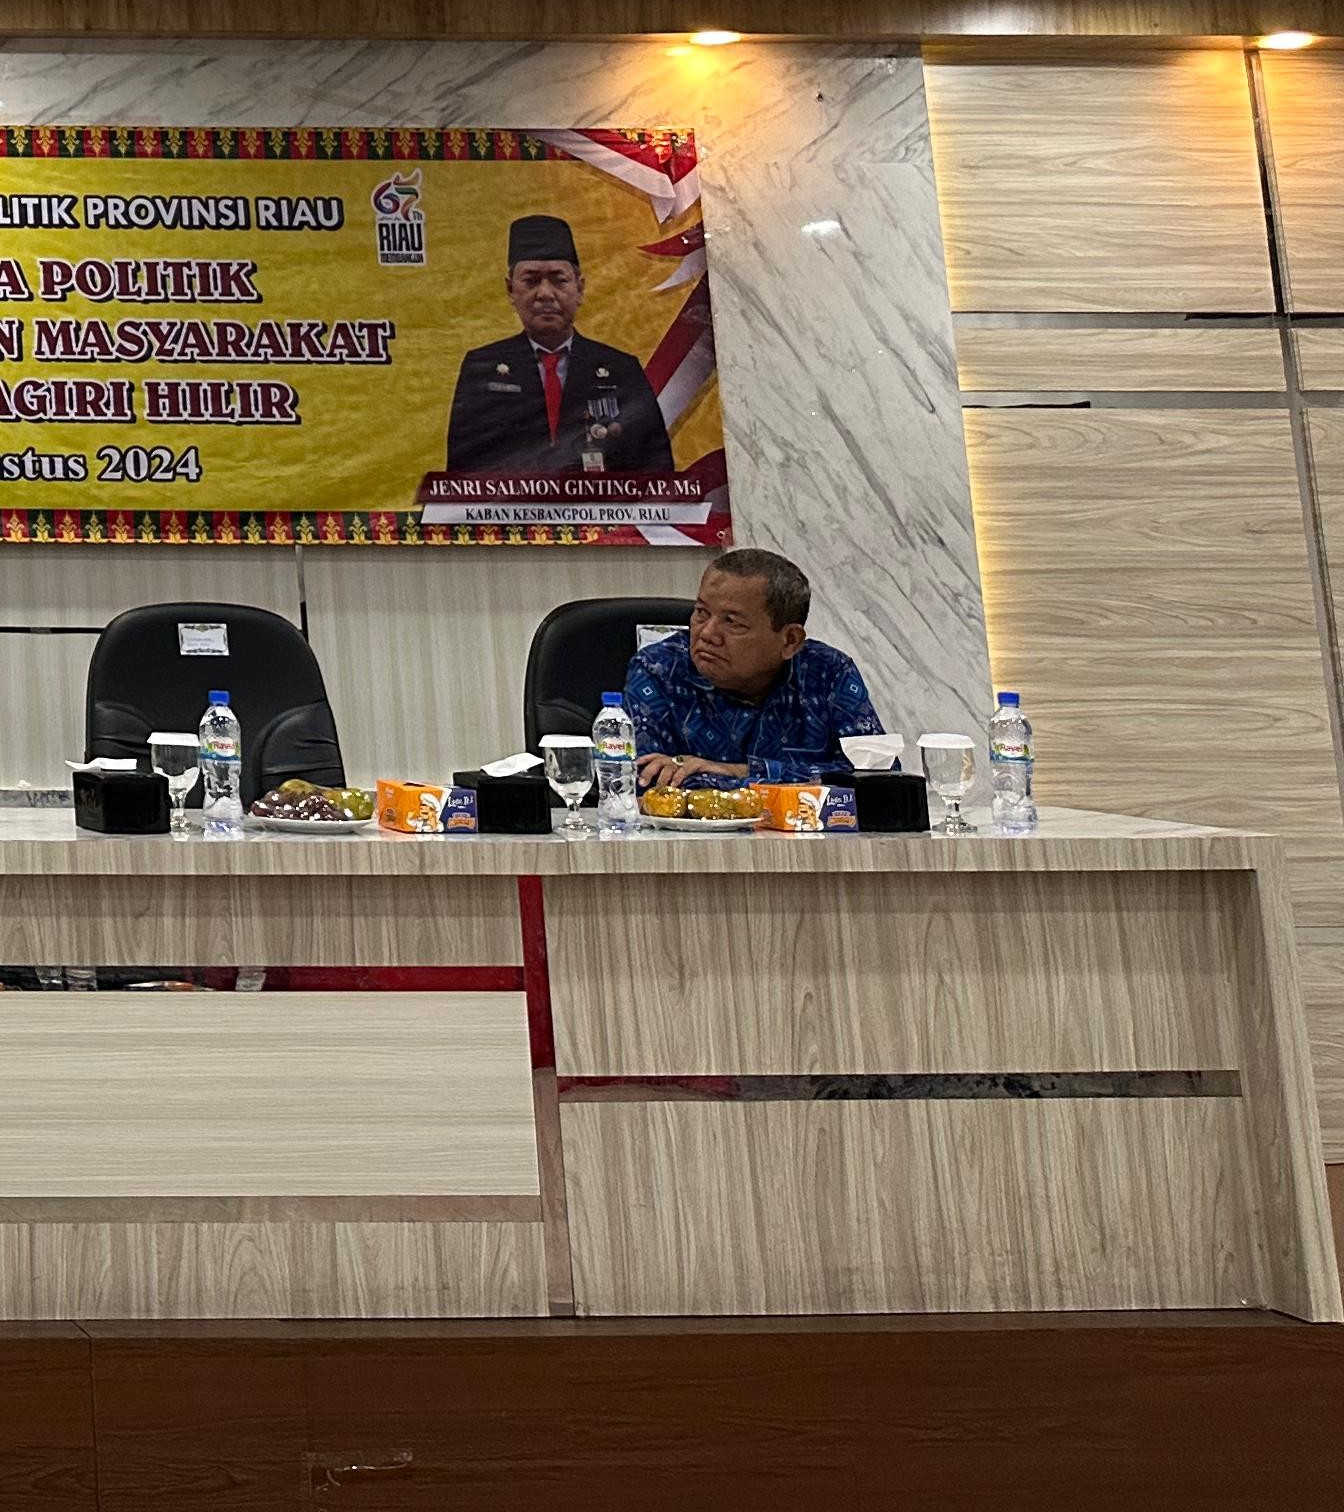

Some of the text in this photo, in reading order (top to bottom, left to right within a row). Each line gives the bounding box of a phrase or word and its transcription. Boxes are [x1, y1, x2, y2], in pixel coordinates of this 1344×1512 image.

[87, 198, 245, 227] PROVINSI
[259, 199, 342, 227] RIAU
[378, 223, 423, 252] RIAU
[38, 260, 258, 301] POLITIK
[34, 320, 393, 362] MASYARAKAT
[143, 381, 298, 423] HILIR
[98, 449, 200, 481] 2024
[429, 480, 701, 498] JENRI SALMON GINTING, AP. Msi
[465, 508, 671, 521] KABAN KESBANGPOL PROV. RIAU
